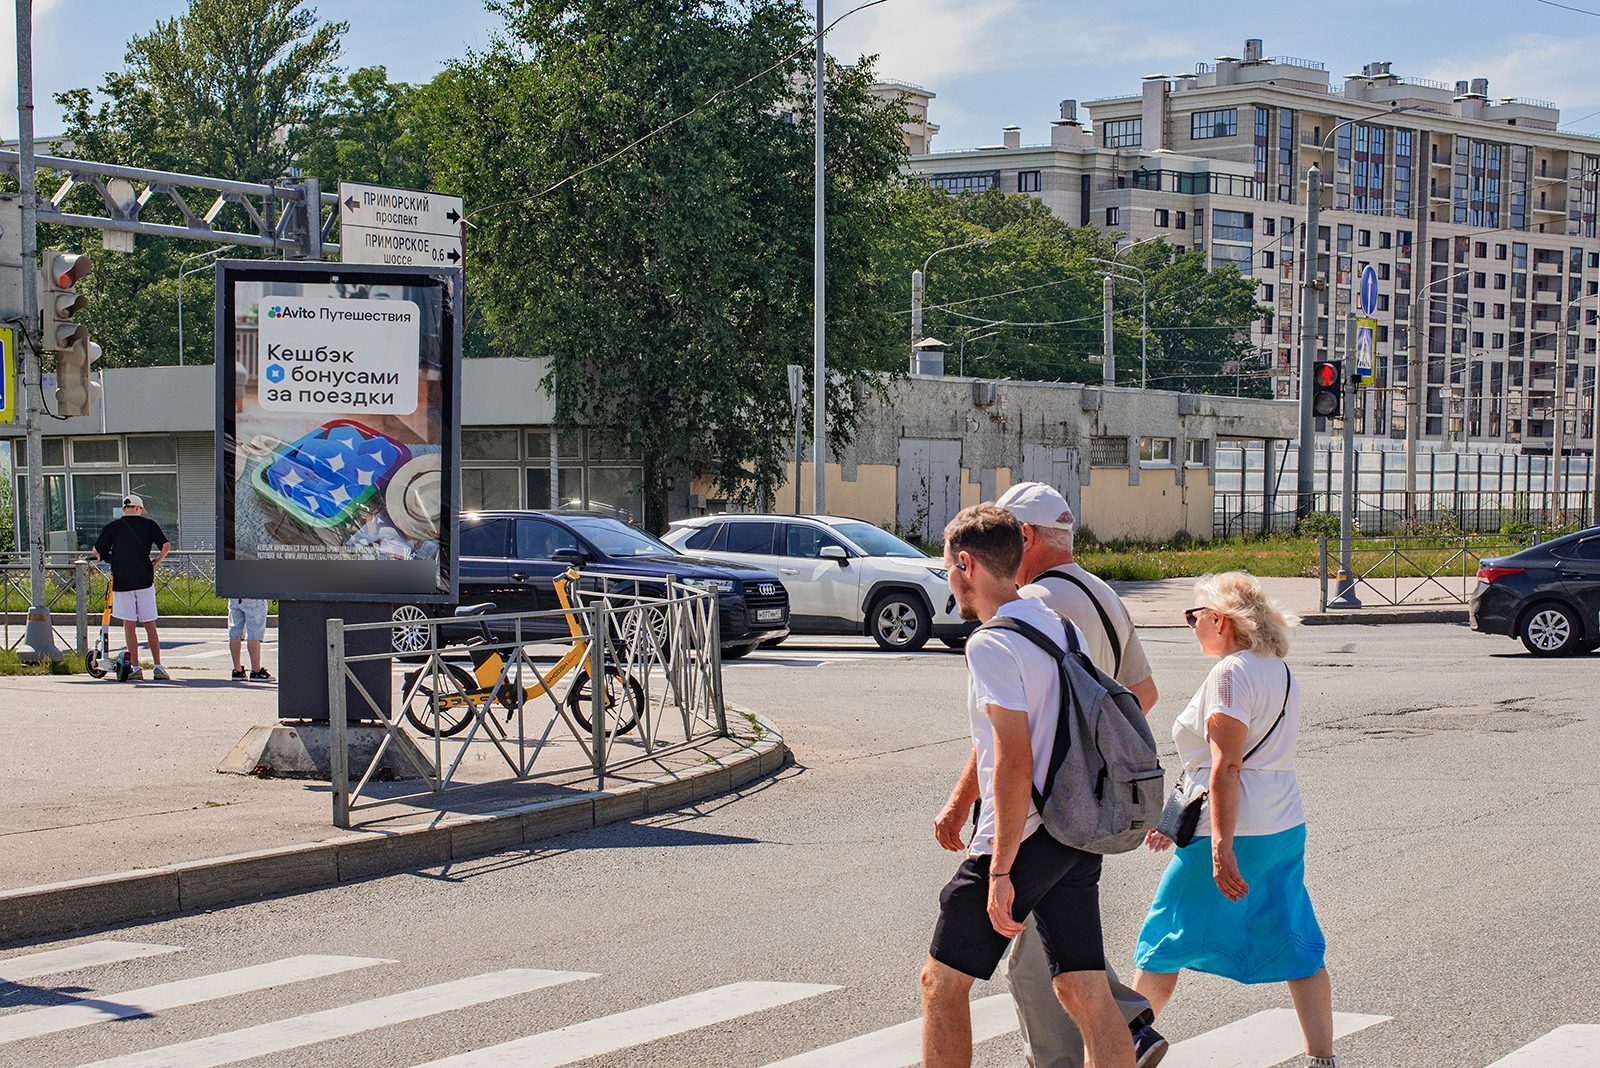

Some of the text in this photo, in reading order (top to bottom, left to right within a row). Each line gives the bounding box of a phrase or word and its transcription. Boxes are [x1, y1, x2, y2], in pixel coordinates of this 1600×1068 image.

[364, 191, 429, 212] ПРИМОРСКИЙ
[376, 211, 418, 226] проспект
[365, 233, 429, 252] ПРИМОРСКОЕ
[383, 254, 412, 265] шоссе
[282, 306, 411, 323] Avito Путешествия
[267, 344, 354, 363] Кешбэк
[291, 365, 399, 387] бонусами
[267, 389, 394, 407] за поездки
[546, 662, 568, 684] WHOOSH
